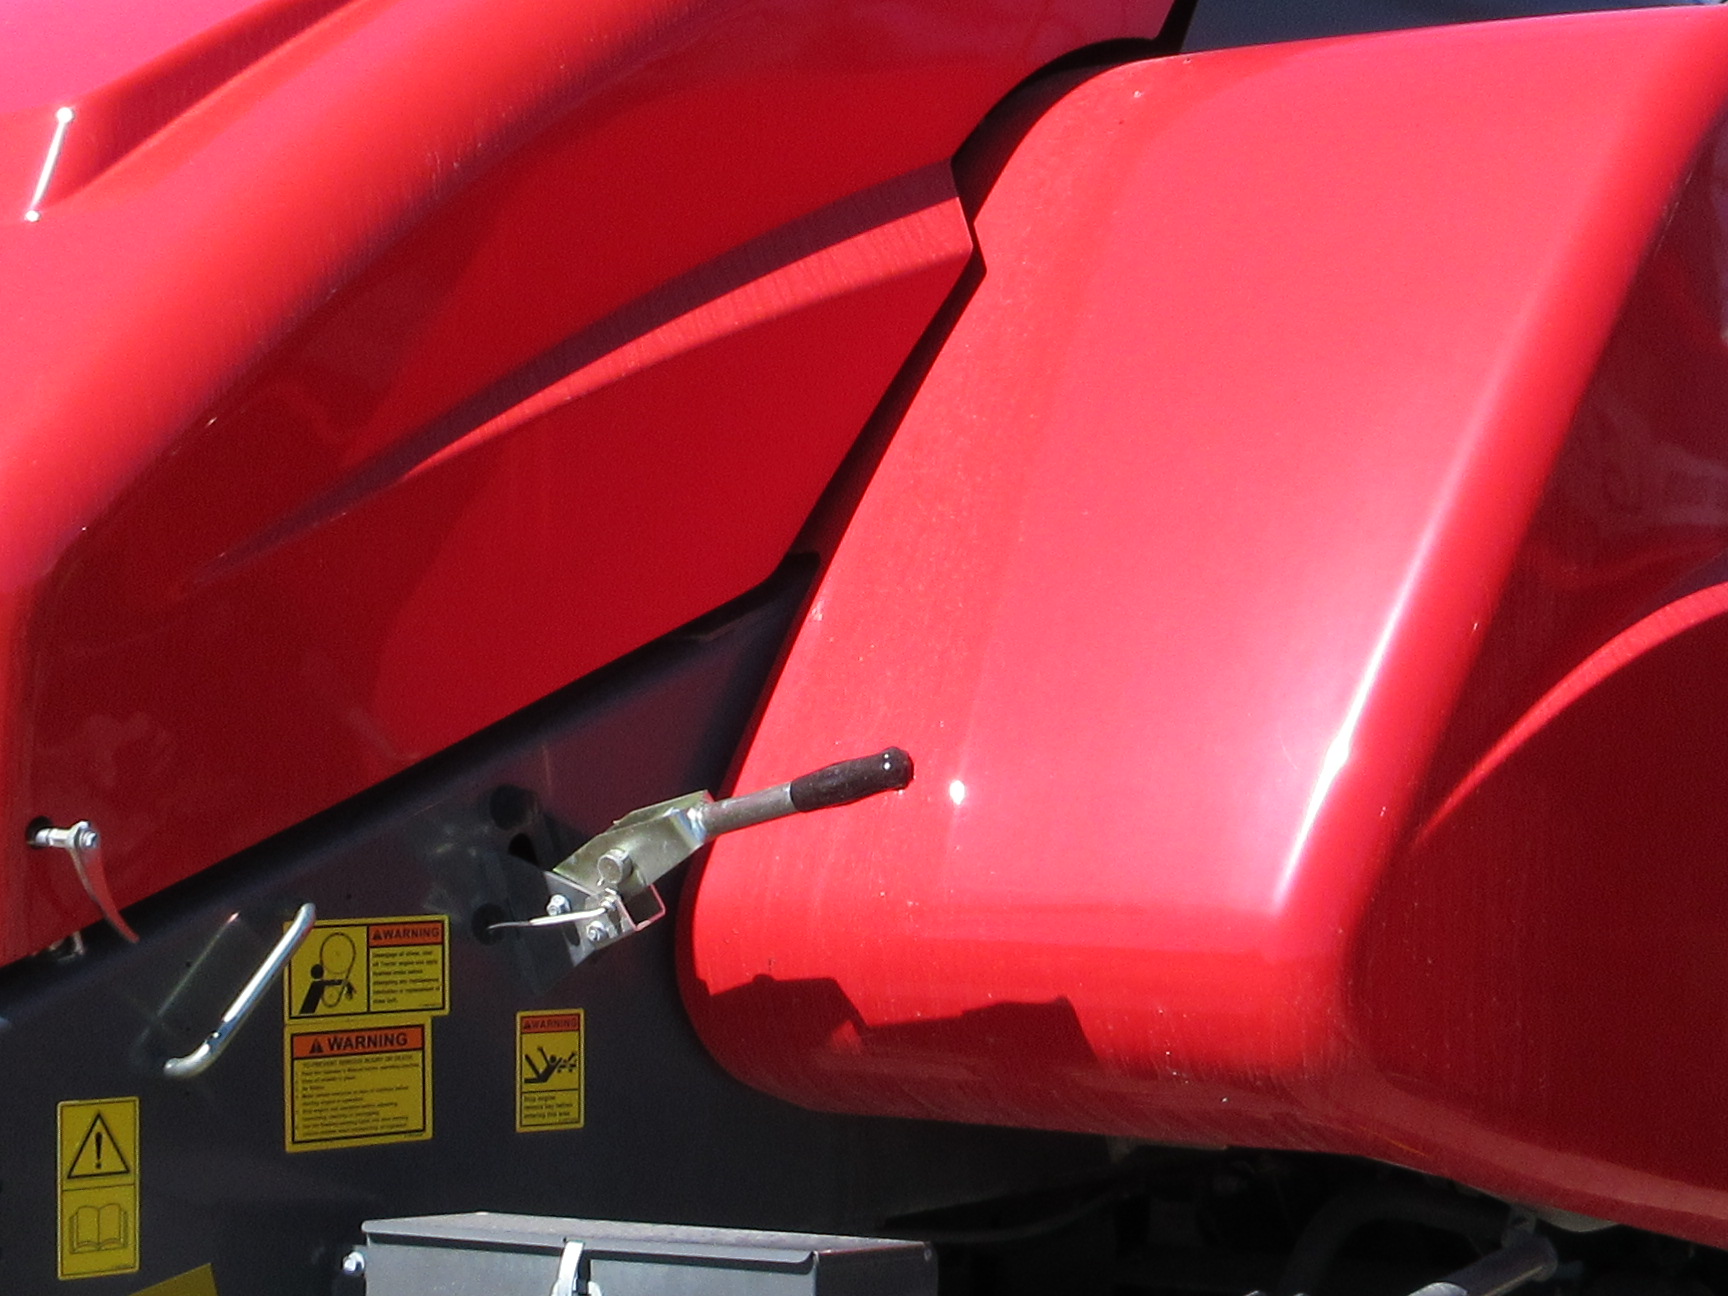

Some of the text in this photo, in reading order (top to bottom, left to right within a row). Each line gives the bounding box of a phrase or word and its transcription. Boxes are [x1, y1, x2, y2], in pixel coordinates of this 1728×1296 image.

[383, 927, 440, 940] WARNING
[531, 1018, 577, 1029] WARNING
[327, 1033, 408, 1051] WARNING
